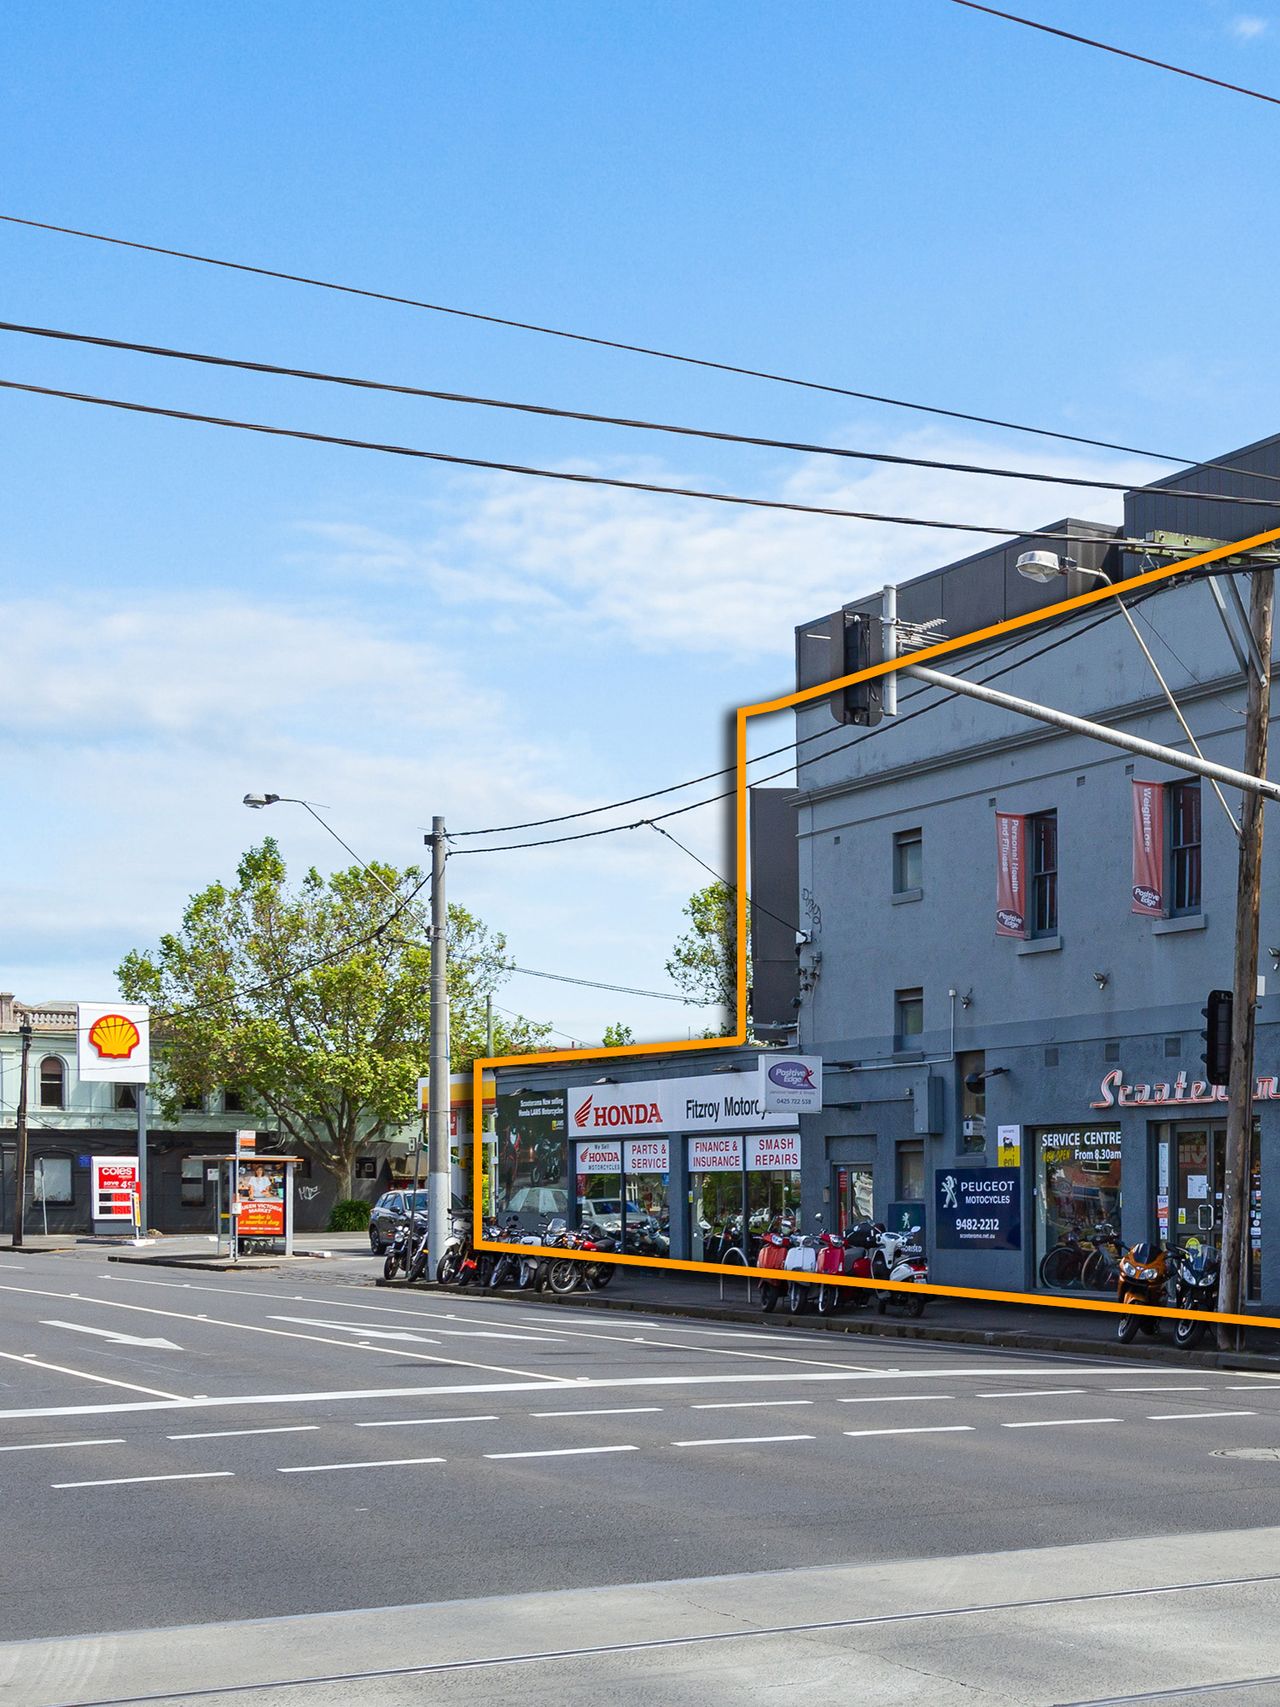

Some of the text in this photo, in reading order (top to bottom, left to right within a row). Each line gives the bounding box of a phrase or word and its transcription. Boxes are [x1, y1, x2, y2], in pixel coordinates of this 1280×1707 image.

[594, 1103, 663, 1126] HONDA
[686, 1096, 772, 1122] Fitzroy Motorc
[759, 1138, 794, 1150] SMASH
[1042, 1131, 1121, 1147] SERVICE CENTRE
[632, 1144, 667, 1155] PARTS &
[695, 1141, 738, 1152] FINANCE &
[589, 1152, 619, 1162] HONDA
[755, 1154, 798, 1166] REPAIRS
[1074, 1149, 1122, 1160] From 8.30am
[631, 1158, 667, 1169] SERVICE
[693, 1156, 740, 1167] INSURANCE
[1003, 1155, 1015, 1166] eni
[101, 1167, 133, 1175] coles
[960, 1181, 1015, 1192] PEUGEOT
[965, 1195, 1010, 1204] MOTOCYCLES
[955, 1218, 1000, 1230] 9482-2212
